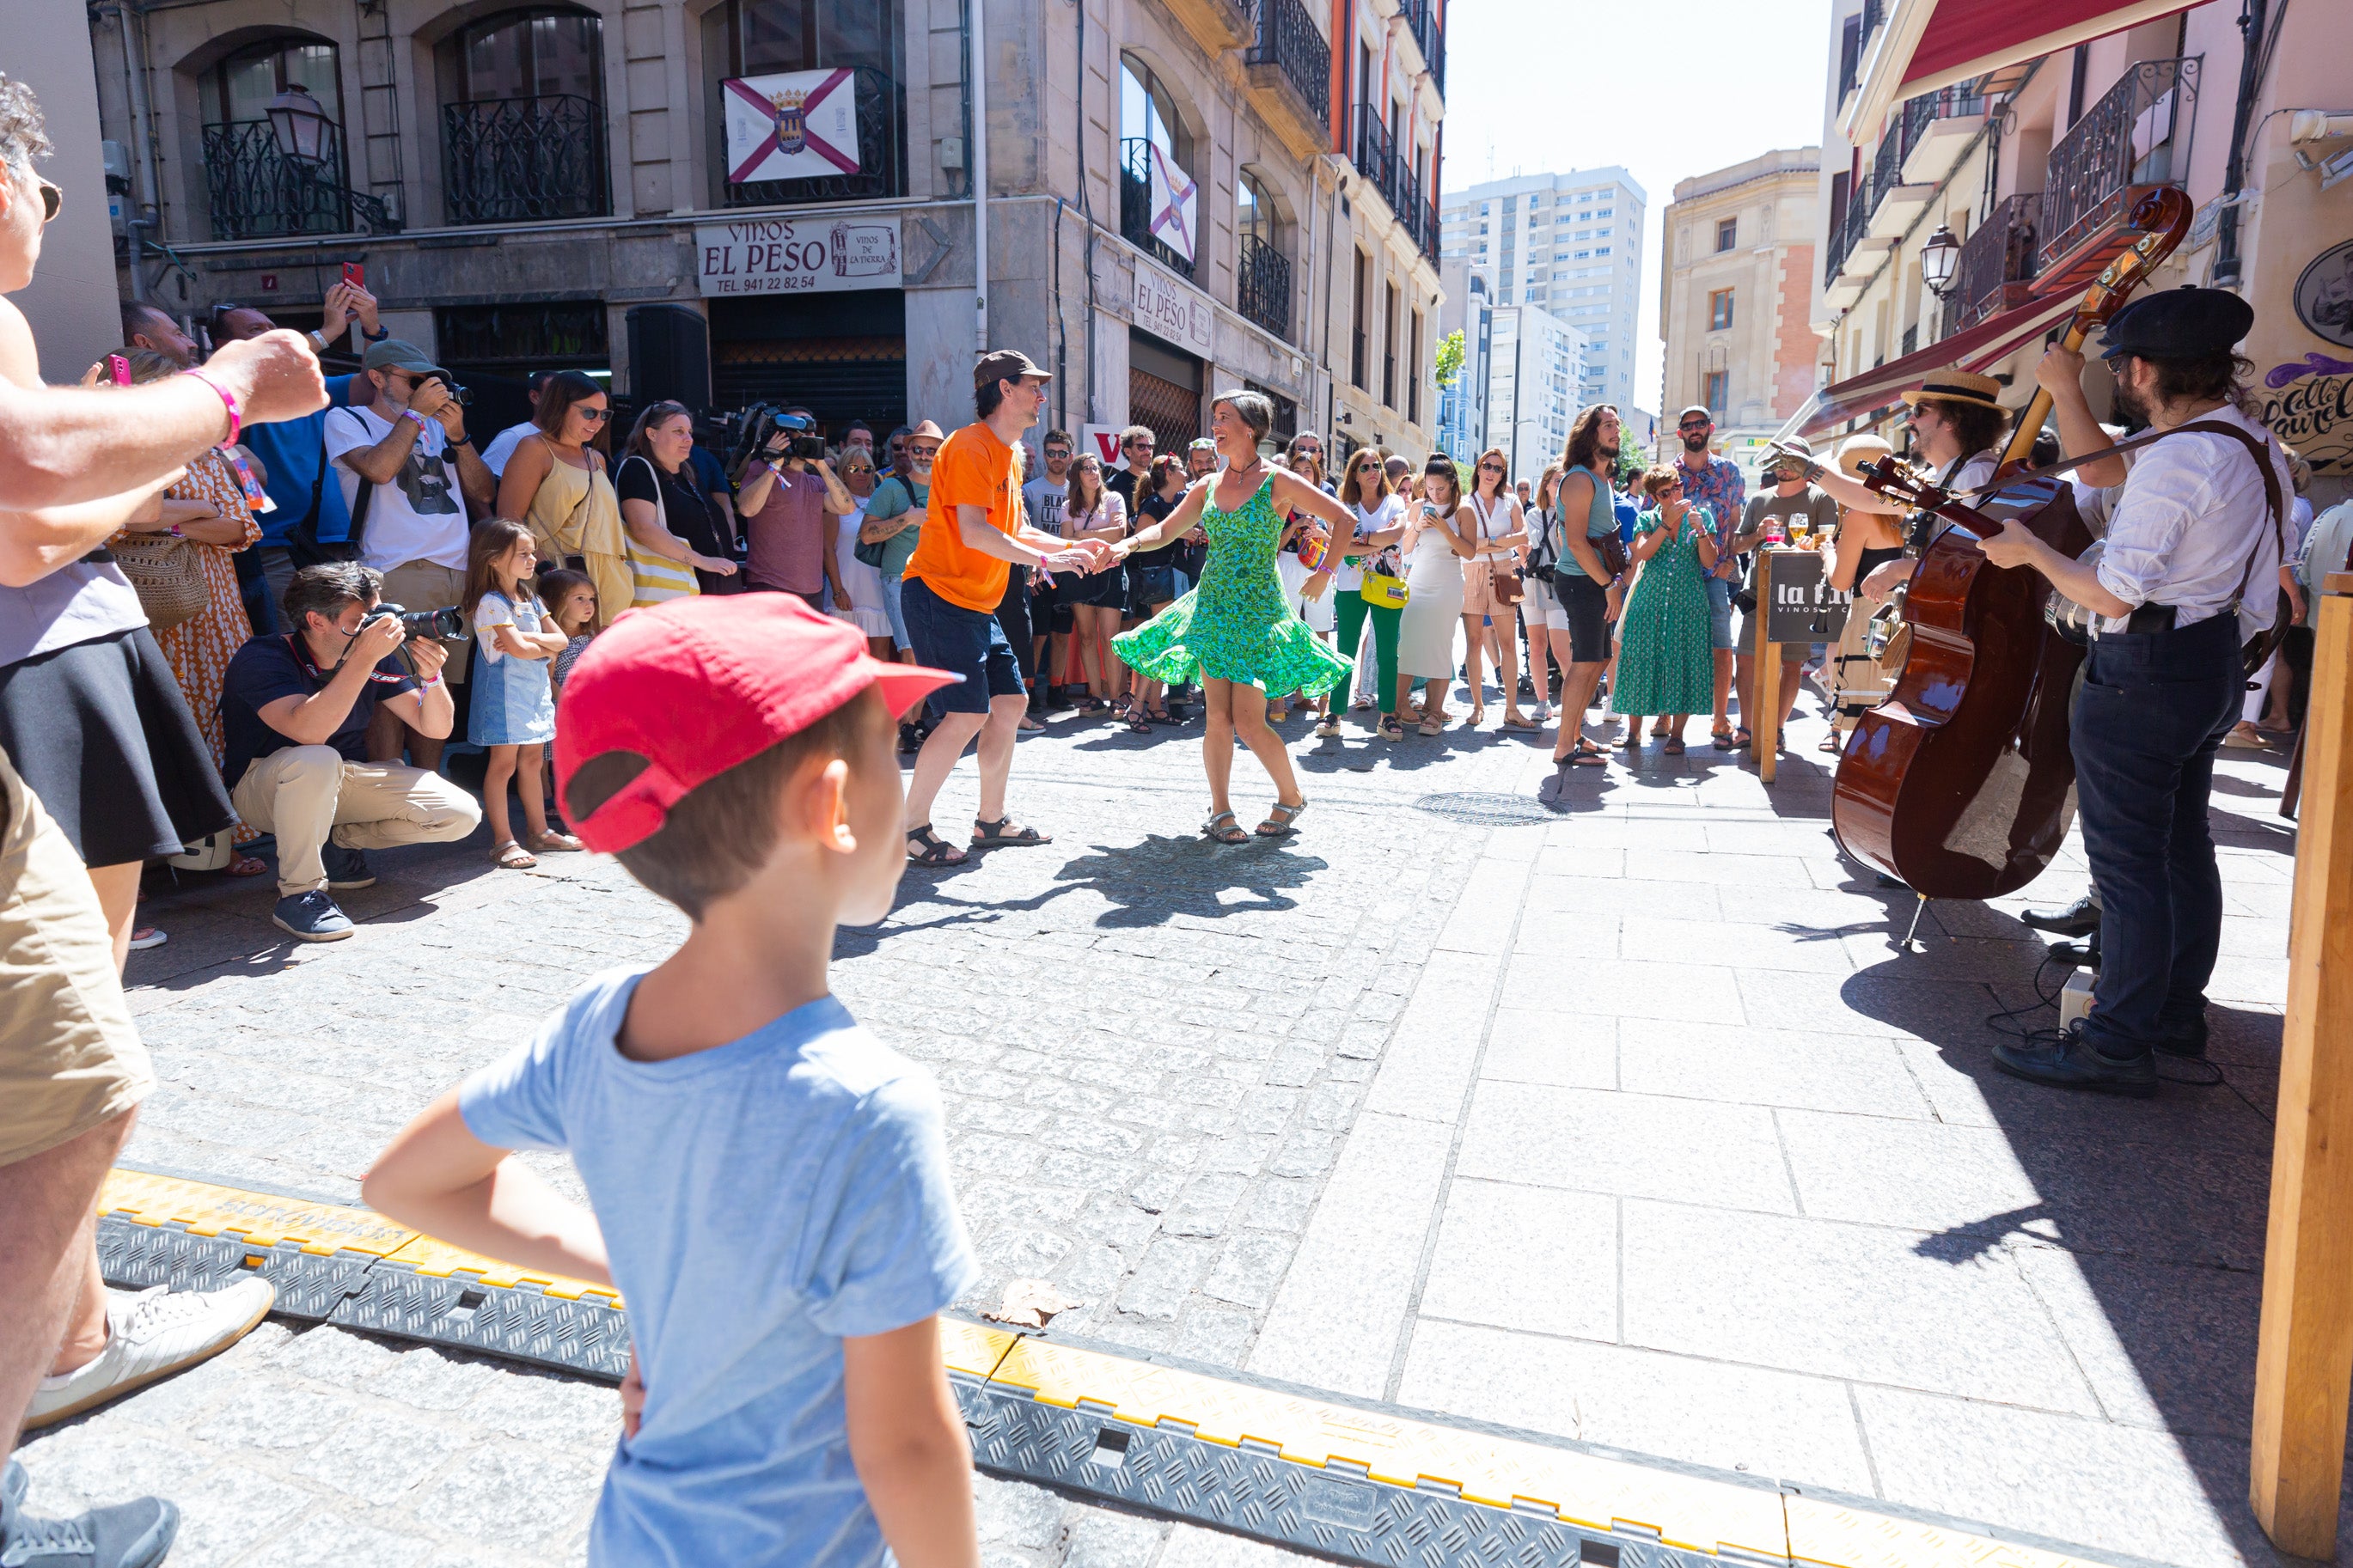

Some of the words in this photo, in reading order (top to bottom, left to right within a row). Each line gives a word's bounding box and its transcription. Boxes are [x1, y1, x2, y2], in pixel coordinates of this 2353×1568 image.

[727, 220, 795, 242] VINOS
[856, 235, 879, 244] VINOS
[704, 246, 736, 276] EL
[745, 241, 826, 273] PESO
[717, 279, 740, 292] TEL.
[744, 278, 763, 291] 941
[767, 278, 780, 290] 22
[784, 277, 798, 289] 82
[801, 276, 815, 288] 54
[1150, 270, 1176, 300] VINOS
[1138, 284, 1152, 314] EL
[1156, 293, 1185, 330] PESO
[1153, 320, 1163, 333] 941
[1164, 326, 1169, 336] 22
[1778, 583, 1805, 605] la
